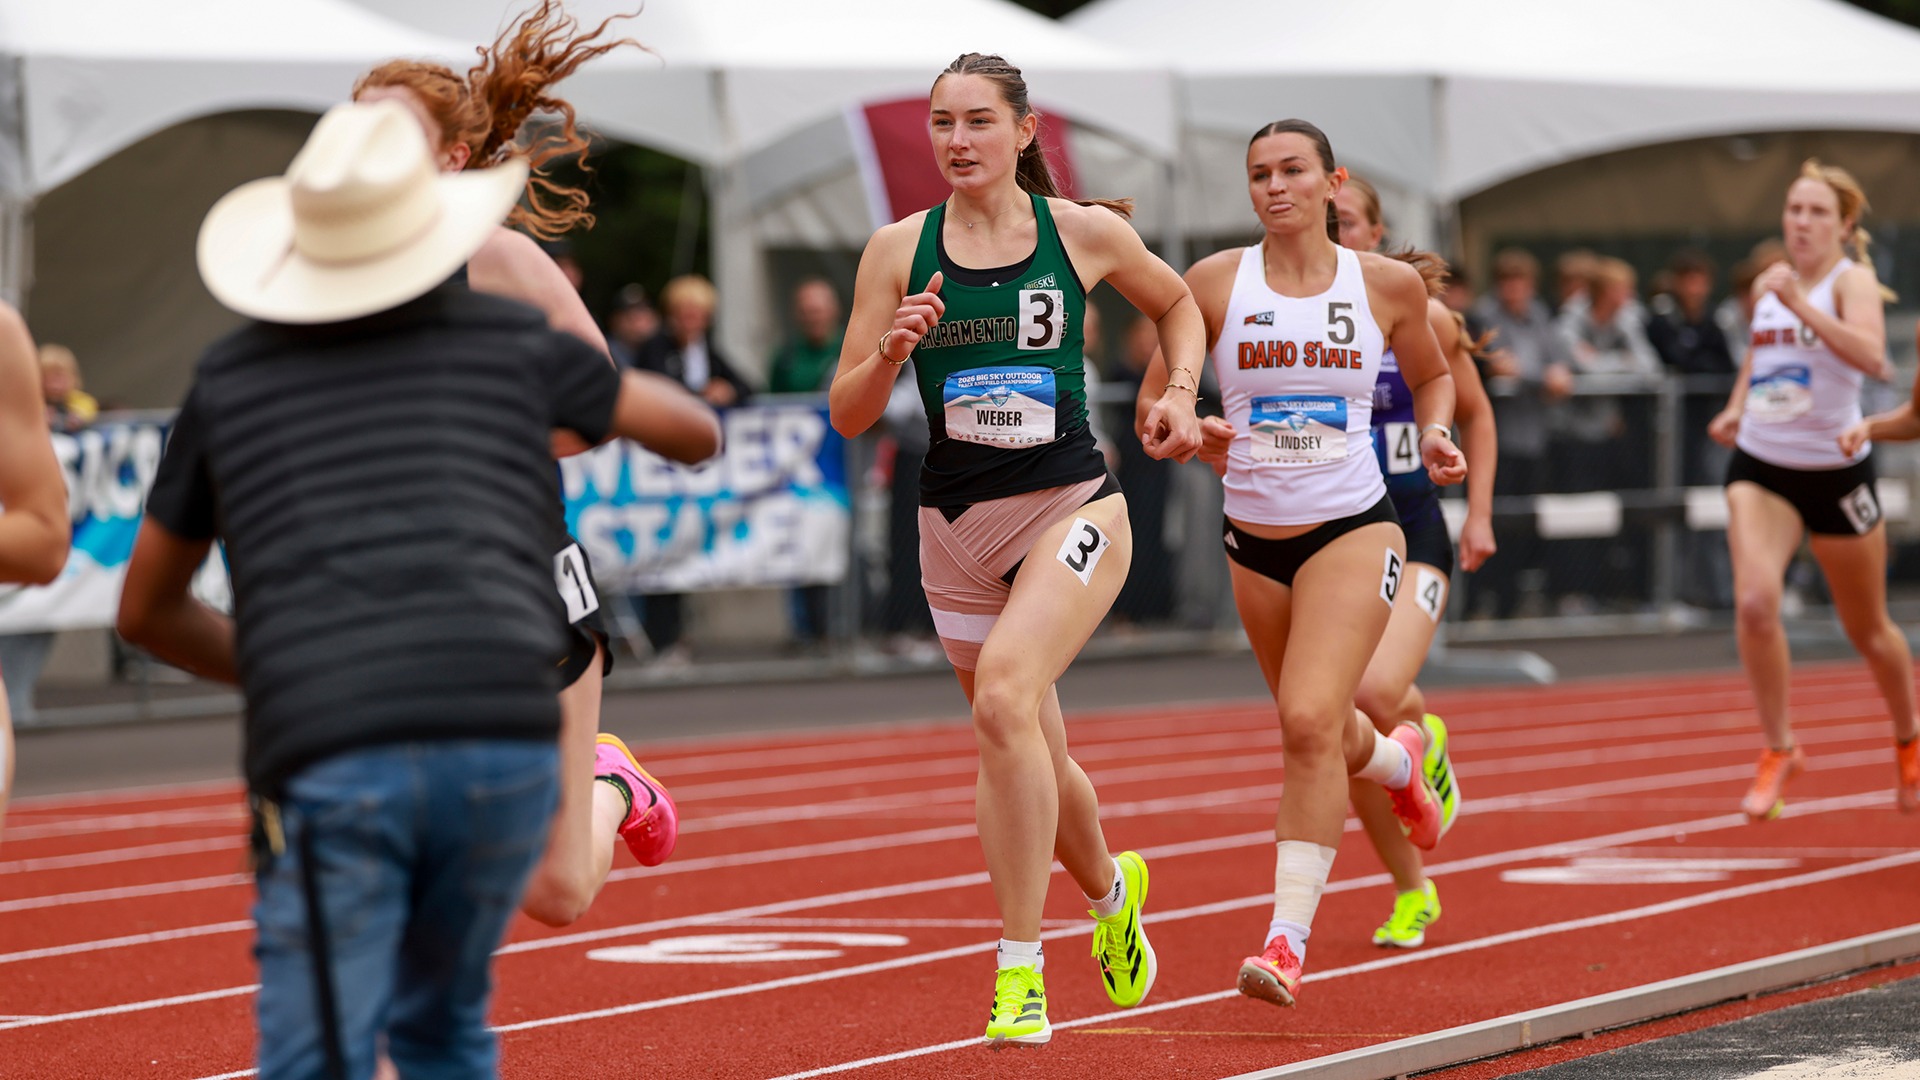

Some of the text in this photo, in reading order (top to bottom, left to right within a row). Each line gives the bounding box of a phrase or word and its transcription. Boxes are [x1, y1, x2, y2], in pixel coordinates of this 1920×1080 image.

[1027, 292, 1054, 347] 3
[1328, 302, 1355, 344] 5
[1238, 340, 1297, 370] IDAHO
[958, 375, 975, 384] 2026
[1005, 372, 1042, 380] OUTDOOR
[976, 409, 1022, 427] WEBER
[1275, 435, 1322, 450] LINDSEY
[1396, 426, 1412, 466] 4
[1065, 524, 1100, 572] 3
[563, 554, 588, 611] 1
[1385, 553, 1400, 602] 5
[1424, 580, 1439, 612] 4
